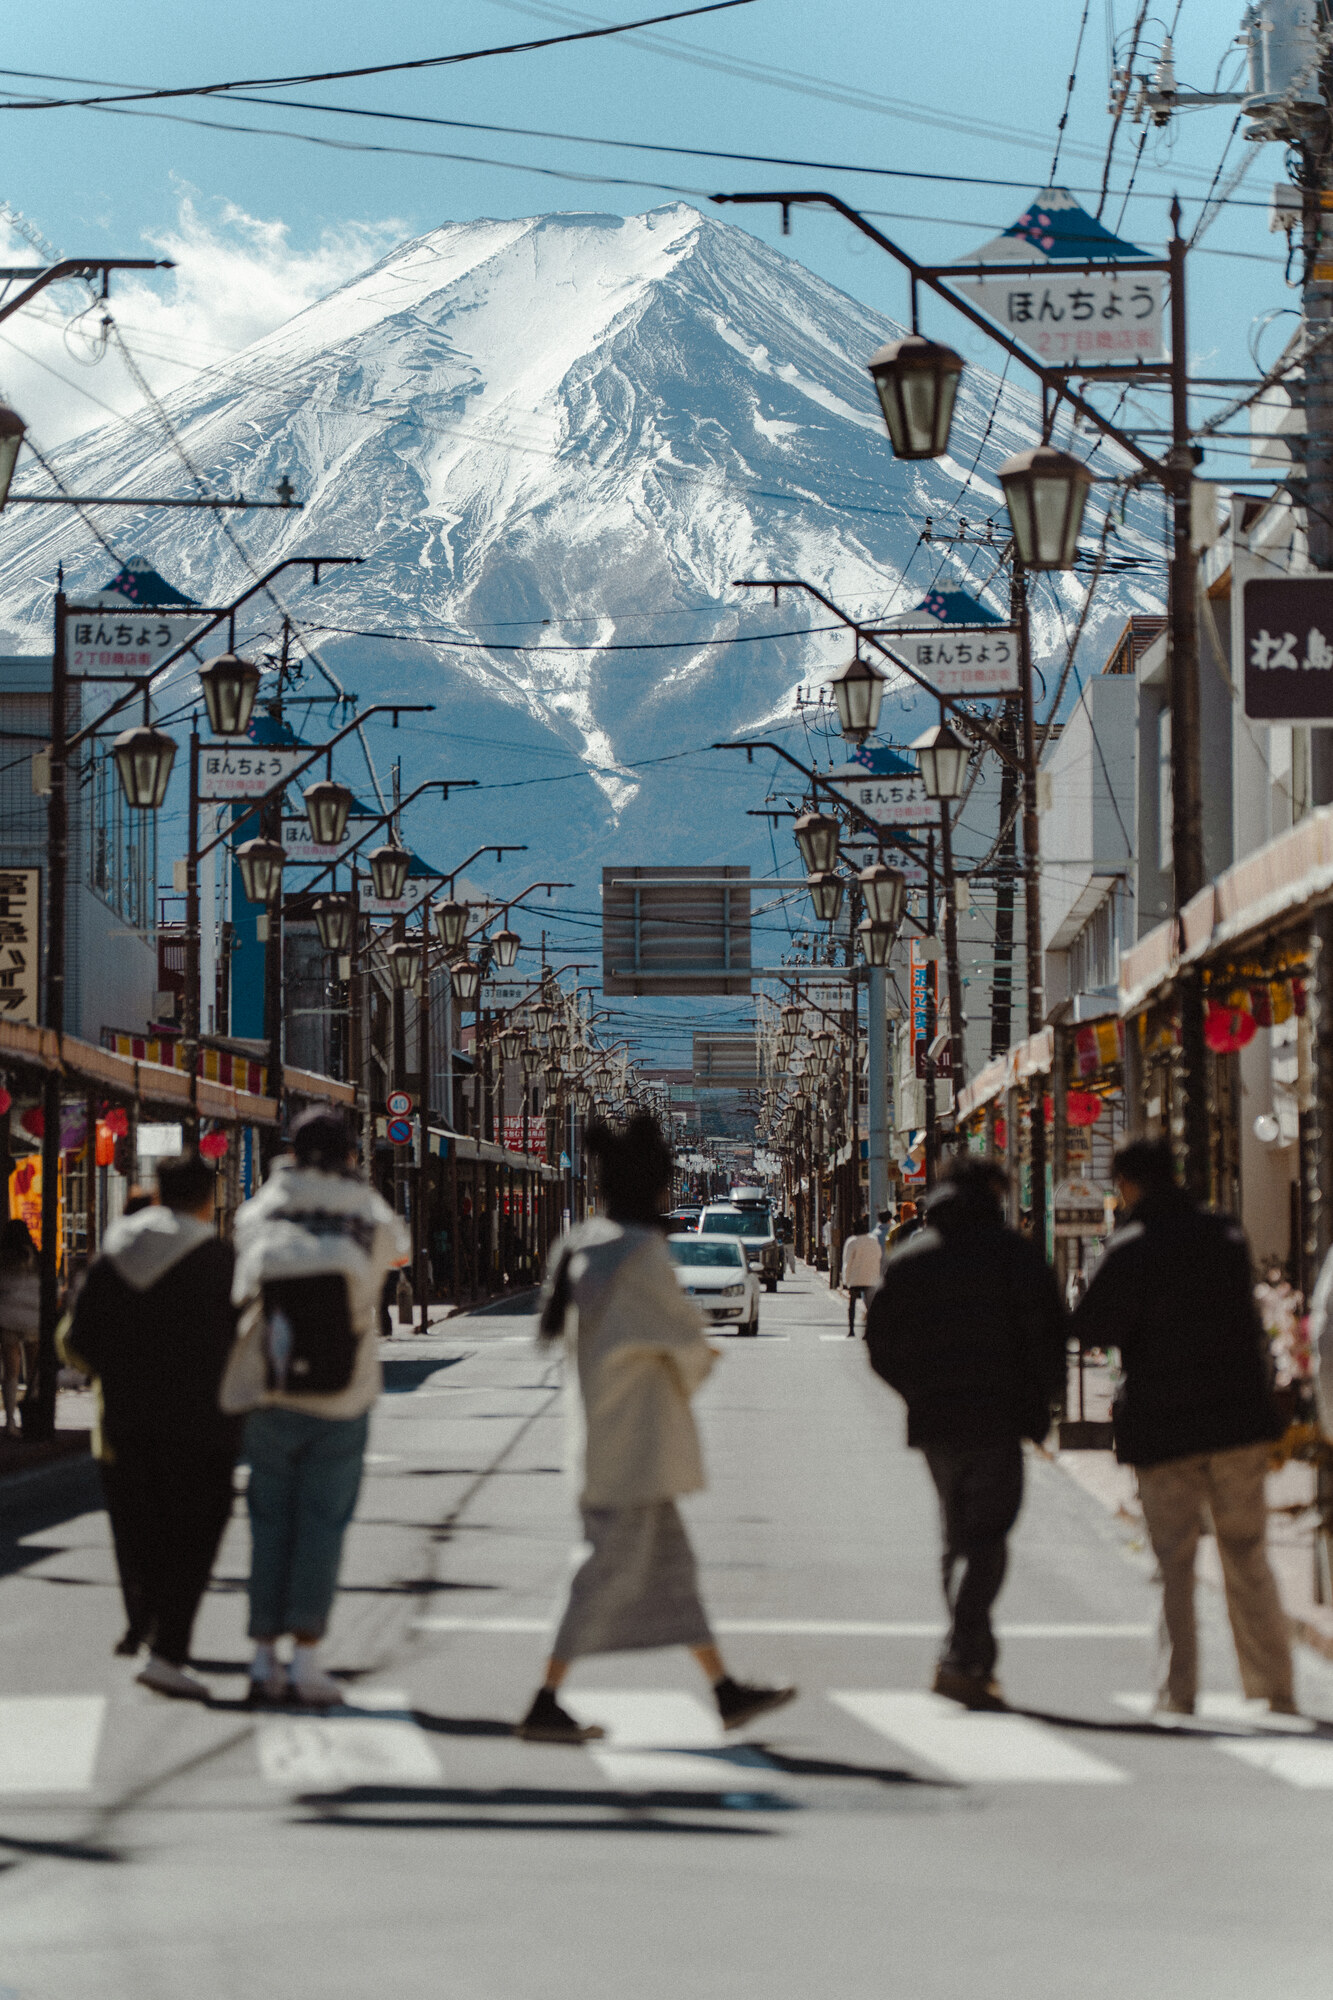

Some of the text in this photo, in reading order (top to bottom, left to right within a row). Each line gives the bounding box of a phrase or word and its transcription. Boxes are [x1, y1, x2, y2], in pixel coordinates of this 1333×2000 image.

[1008, 285, 1154, 322] ほんちょう
[75, 623, 172, 647] ほんちょう
[917, 641, 1011, 665] ほんちょう
[206, 757, 282, 776] ほんちょう
[393, 1100, 407, 1110] 40
